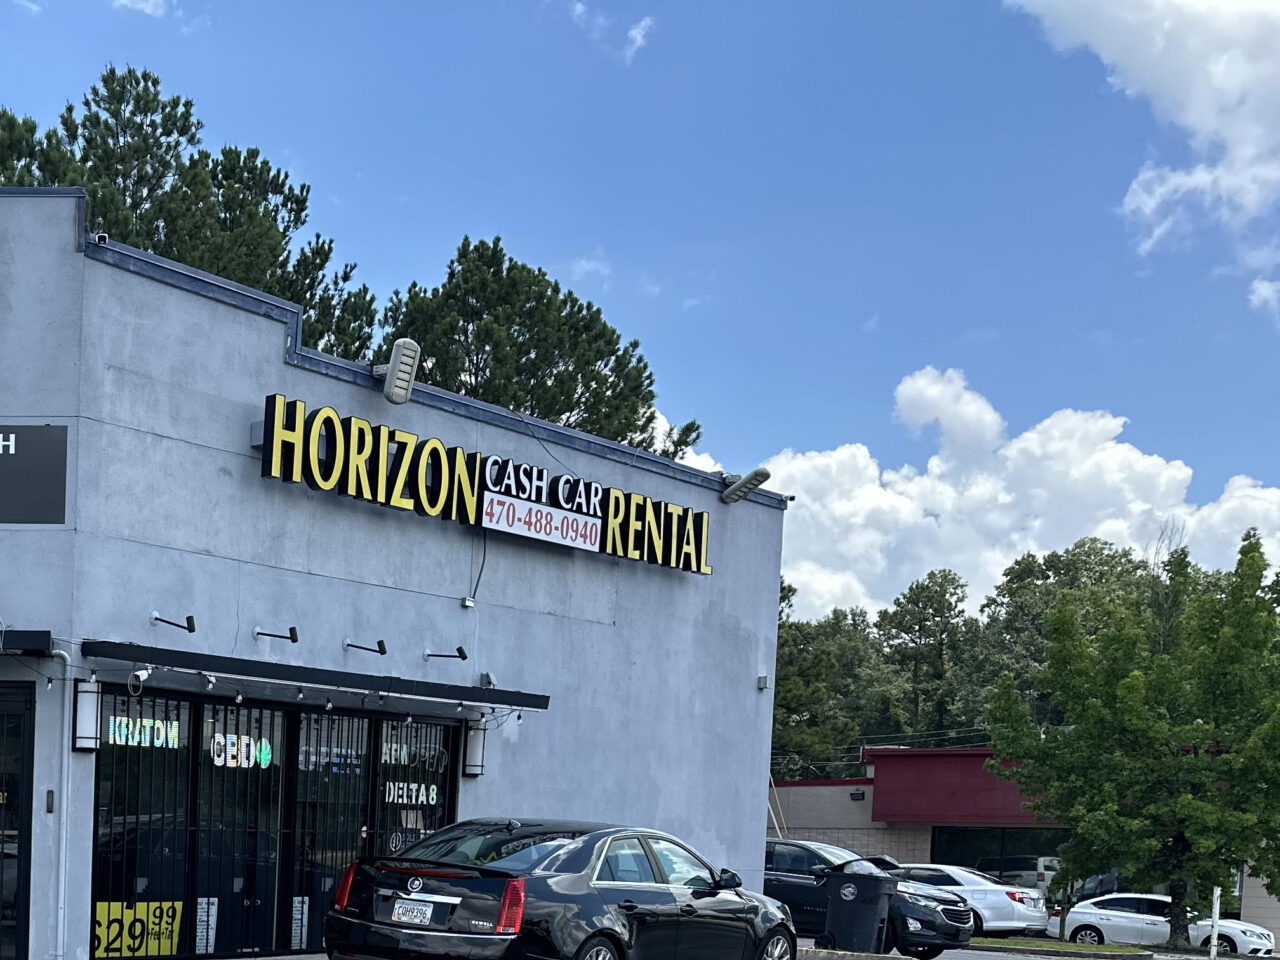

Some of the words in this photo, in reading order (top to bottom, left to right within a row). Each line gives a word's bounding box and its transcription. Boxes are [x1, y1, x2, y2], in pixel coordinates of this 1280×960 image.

[266, 393, 482, 526] HORIZON
[484, 455, 549, 504] CASH
[556, 476, 604, 518] CAR
[484, 497, 599, 548] 470-488-0940
[606, 487, 714, 576] RENTAL
[108, 716, 180, 749] KRATOM
[210, 733, 256, 769] CBD
[385, 781, 427, 805] DELTA
[428, 784, 438, 806] 8
